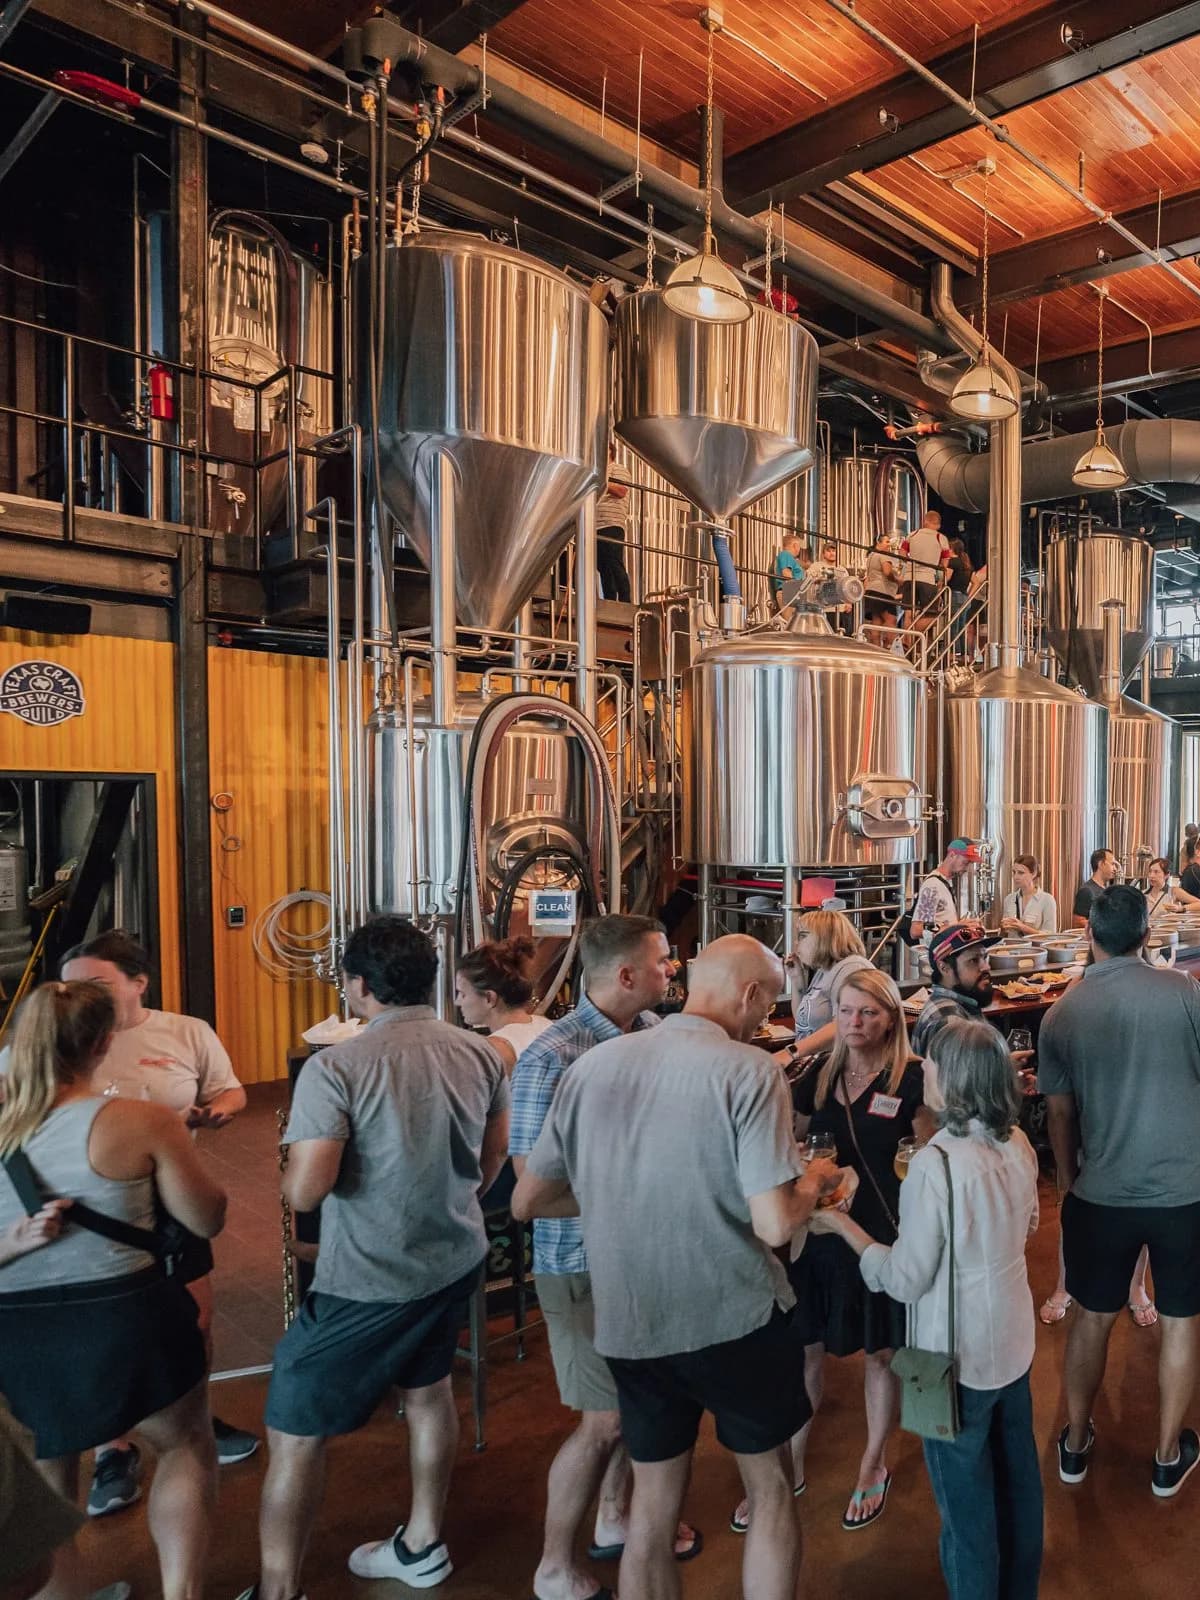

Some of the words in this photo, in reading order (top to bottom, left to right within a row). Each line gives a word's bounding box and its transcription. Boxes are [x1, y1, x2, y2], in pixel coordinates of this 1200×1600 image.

[5, 665, 39, 693] TEXAS
[43, 666, 77, 697] CRAFT
[7, 693, 75, 710] BREWERS
[20, 707, 65, 722] GUILD
[536, 903, 571, 911] CLEAN
